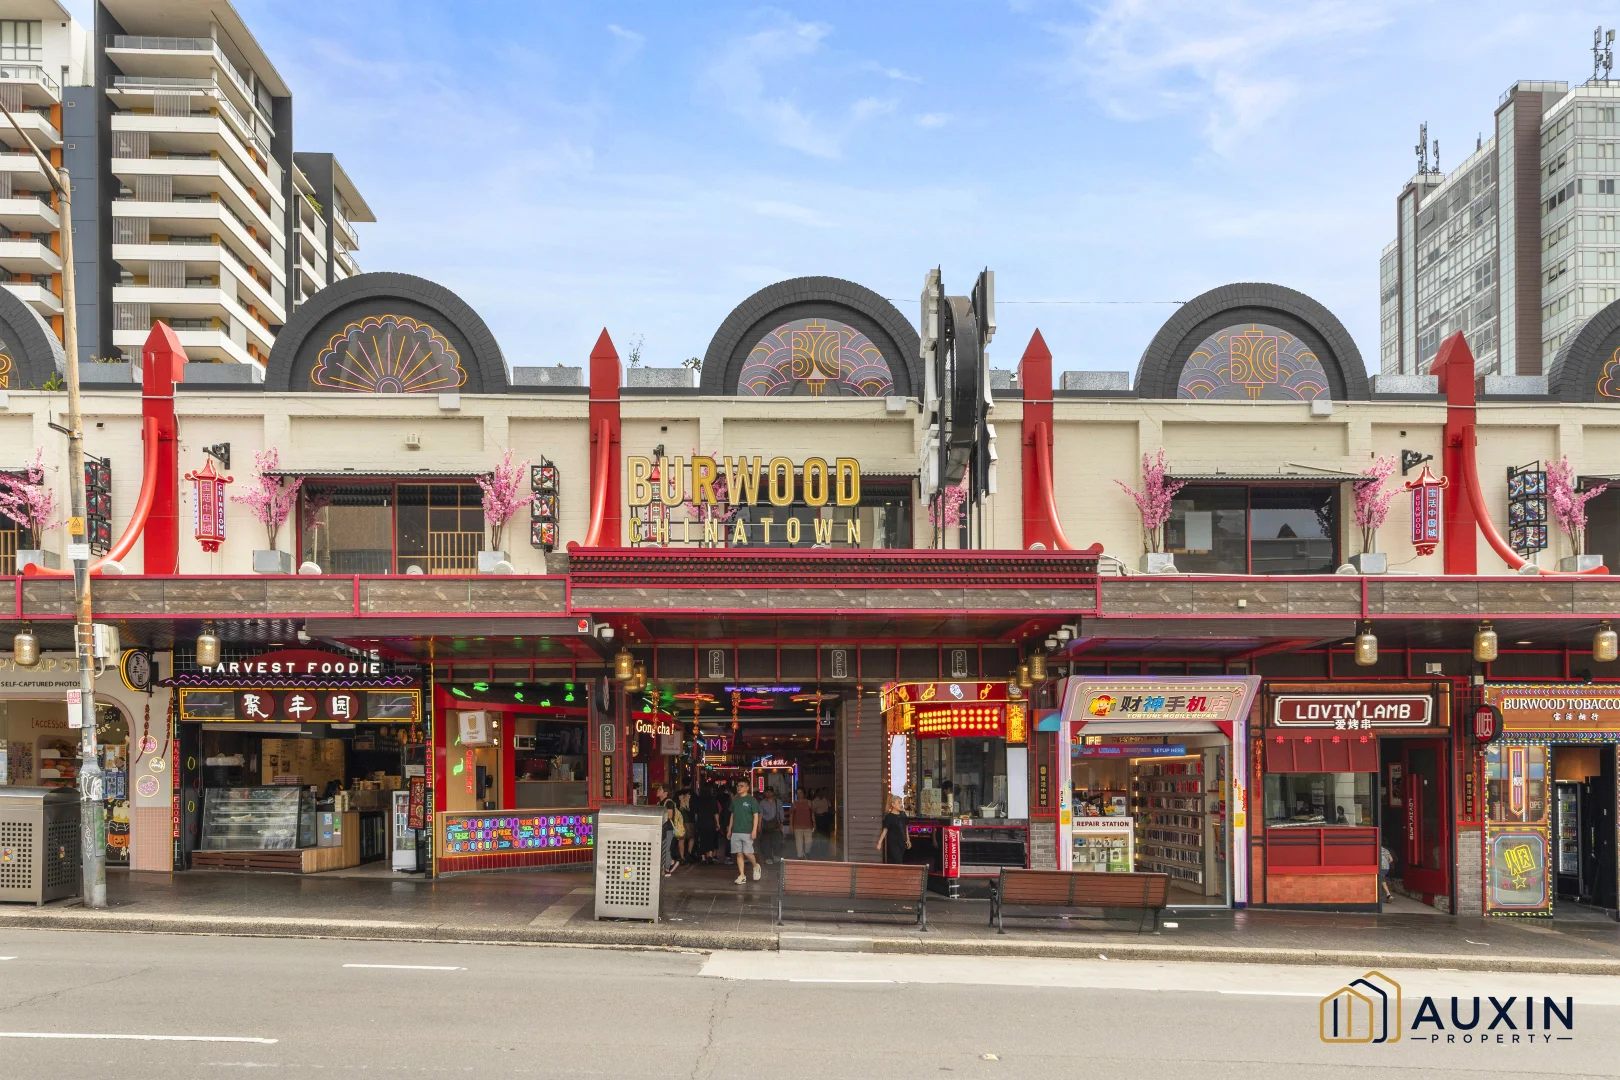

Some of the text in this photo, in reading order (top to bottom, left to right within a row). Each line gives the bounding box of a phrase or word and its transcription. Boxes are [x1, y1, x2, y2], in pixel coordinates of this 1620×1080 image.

[627, 456, 861, 507] BURWOOD
[629, 517, 861, 544] CHINATOWN
[202, 662, 381, 674] HARVEST FOODIE
[244, 694, 352, 719] 聚丰园
[1119, 695, 1230, 713] 财神手机店
[1296, 700, 1411, 719] LOVIN' LAMB
[1503, 699, 1620, 710] BURWOOD TOBACCO
[657, 722, 671, 735] cha
[1335, 719, 1371, 730] 爱烤串
[1476, 711, 1493, 737] 烟
